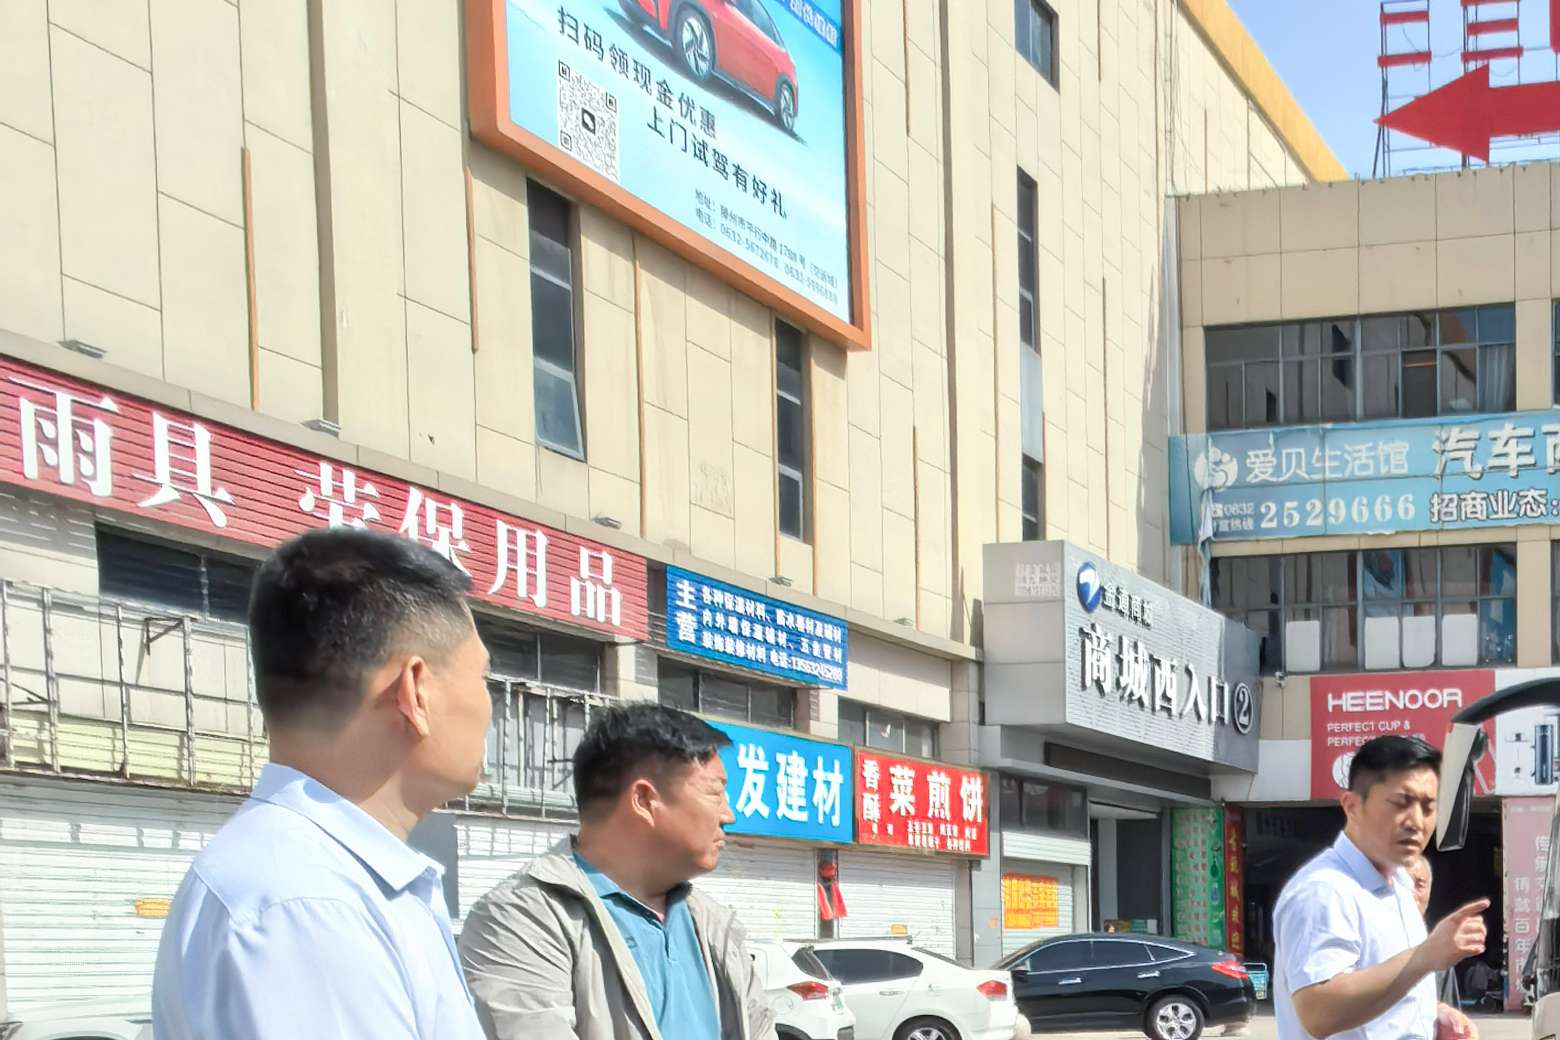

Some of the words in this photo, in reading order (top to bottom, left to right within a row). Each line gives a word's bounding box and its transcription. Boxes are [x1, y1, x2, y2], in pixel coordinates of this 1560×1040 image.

[557, 6, 718, 139] 扫码领现金优惠
[647, 106, 788, 219] 上门试驾有好礼
[7, 376, 236, 530] 雨具
[1246, 440, 1410, 484] 爱贝生活馆
[1260, 493, 1416, 529] 2529666
[676, 580, 698, 644] 主营
[1081, 623, 1229, 725] 商城西入口
[1327, 688, 1463, 713] HEENOOR
[1327, 721, 1375, 733] PERFECT
[1378, 720, 1401, 732] CUP
[888, 764, 984, 823] 菜煎饼
